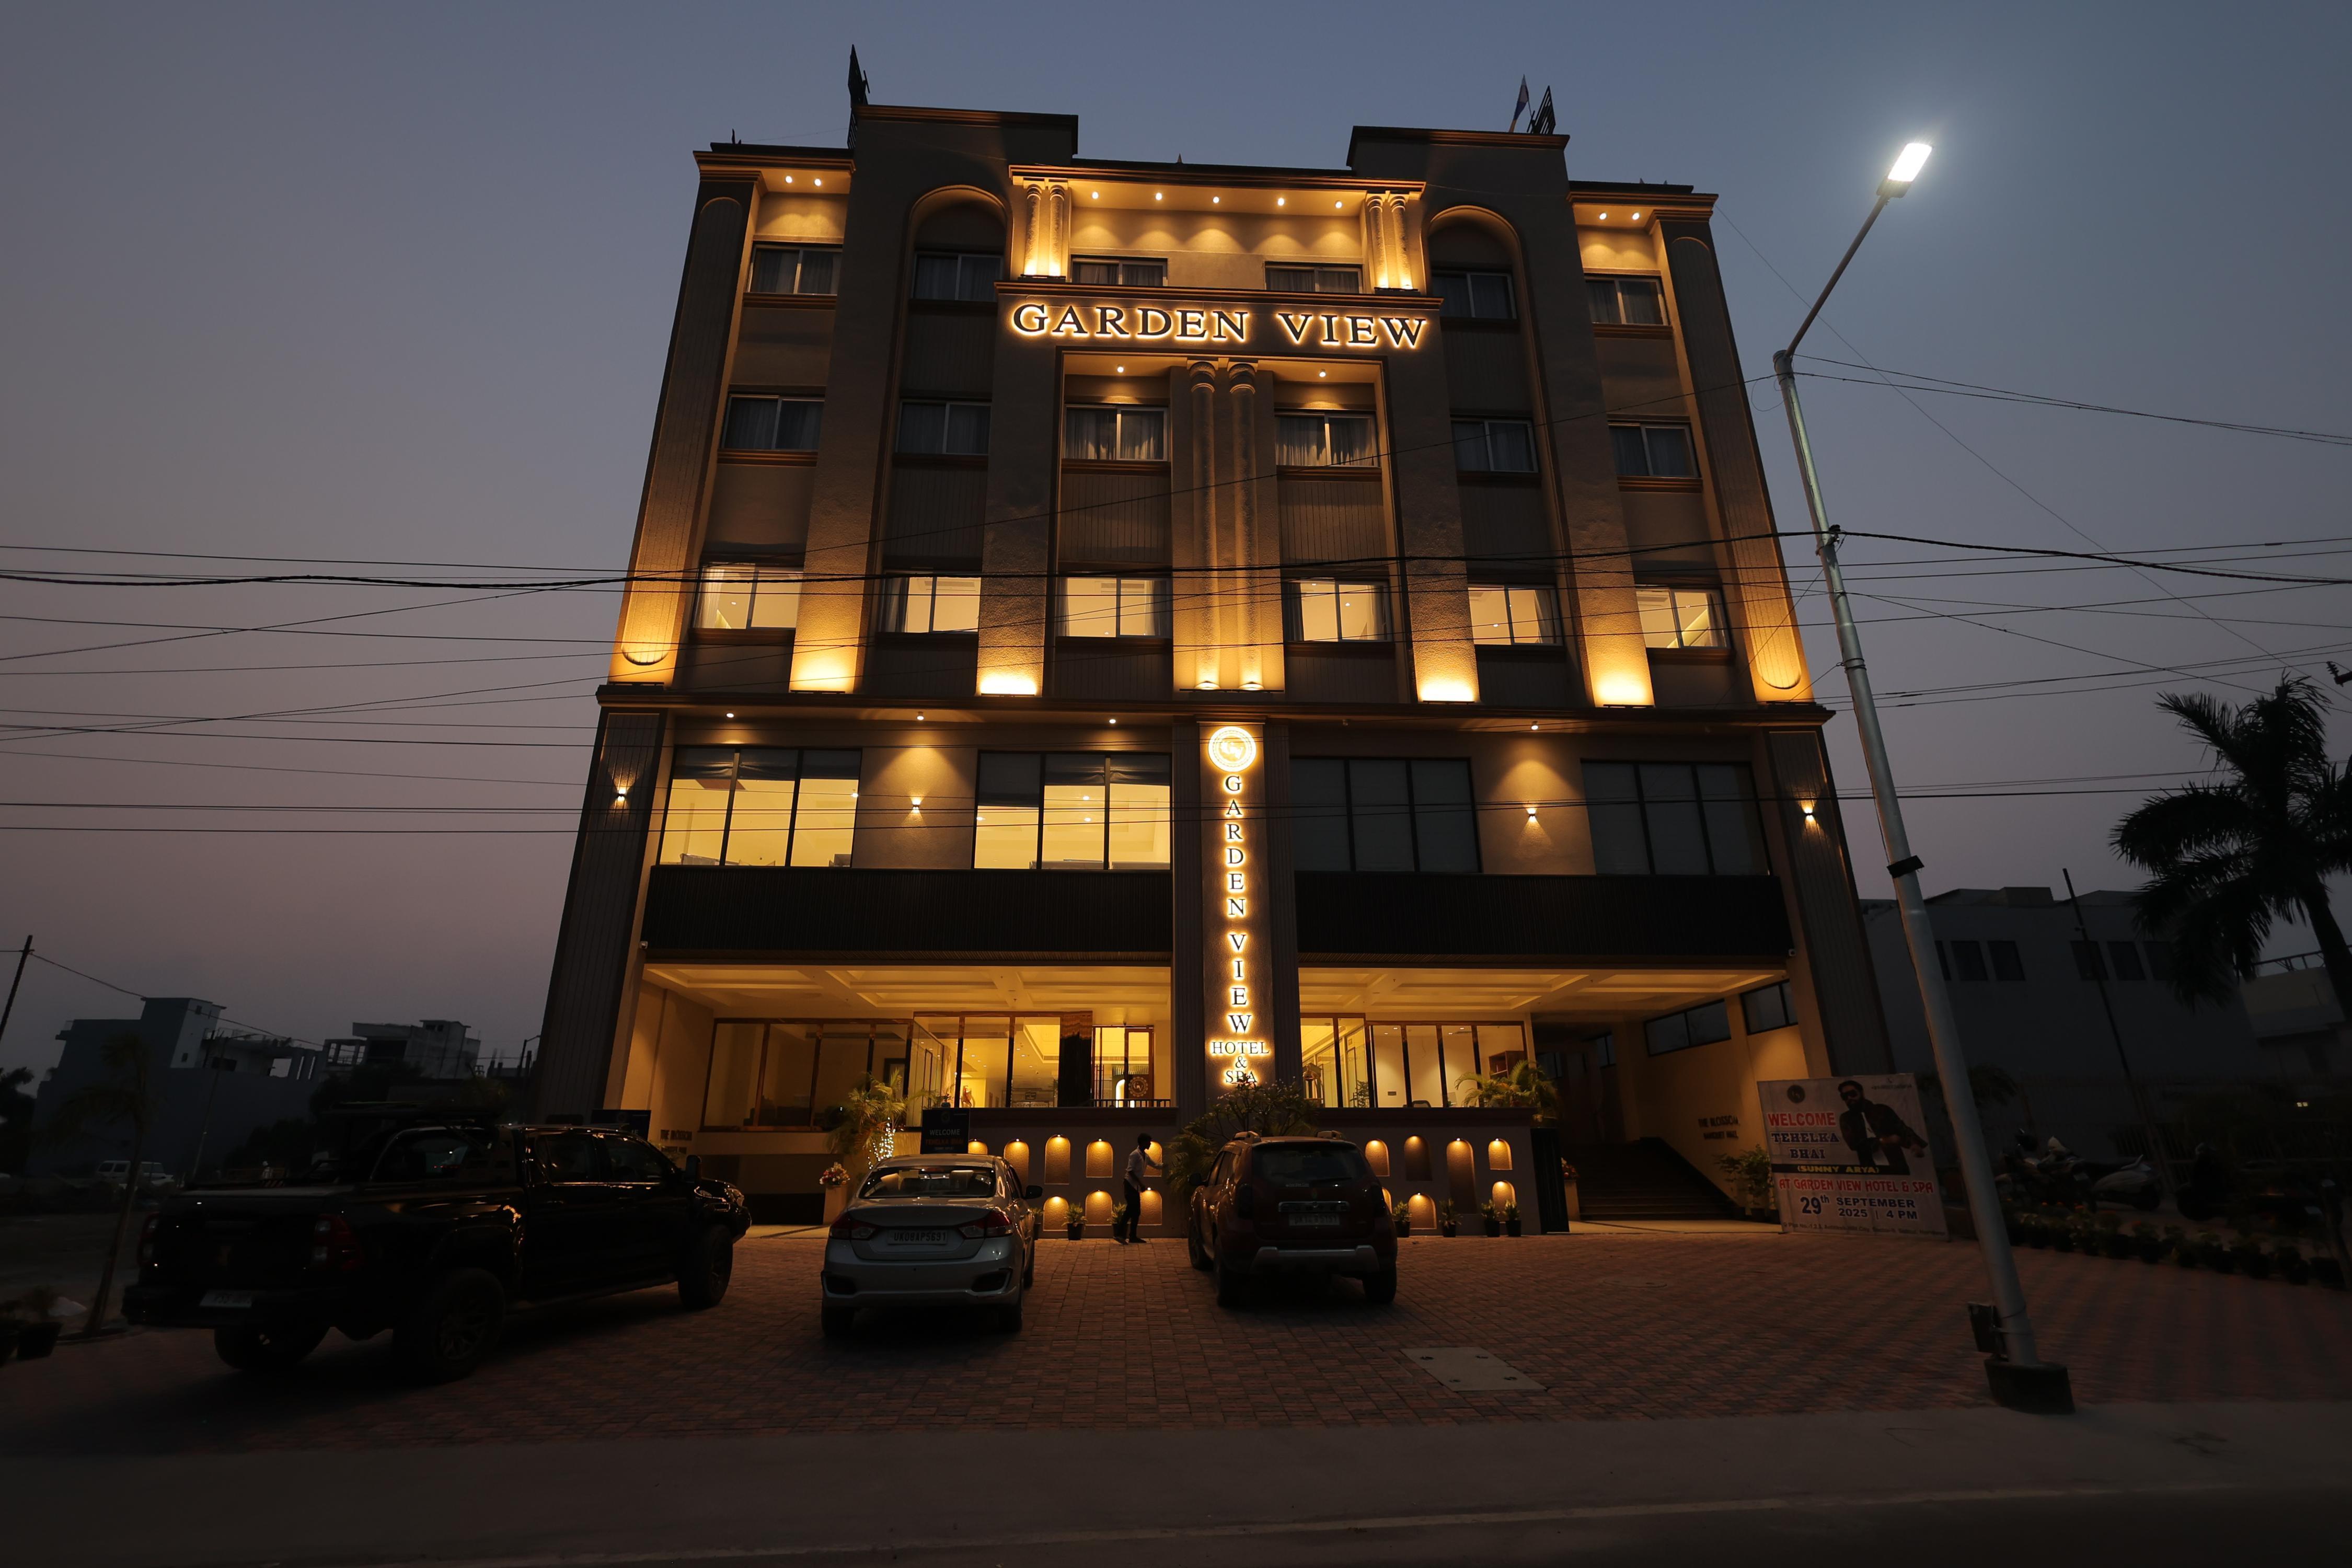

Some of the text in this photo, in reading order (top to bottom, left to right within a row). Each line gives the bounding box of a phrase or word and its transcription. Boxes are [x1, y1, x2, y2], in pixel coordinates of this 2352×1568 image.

[1013, 304, 1426, 347] GARDEN VIEW
[1225, 776, 1251, 1033] GARDEN VIEW
[1211, 1042, 1270, 1054] HOTEL
[1235, 1056, 1247, 1068] &
[1768, 1112, 1836, 1126] WELCOME
[1772, 1132, 1840, 1143] TEHELKA
[1790, 1149, 1826, 1159] BHAI
[1797, 1165, 1880, 1174] (SUNNY ARYA)
[1779, 1179, 1933, 1193] AT GARDEN VIEW HOTEL & SPA
[1836, 1197, 1916, 1208] SEPTEMBER
[1838, 1208, 1867, 1217] 2025
[1898, 1210, 1918, 1219] PM
